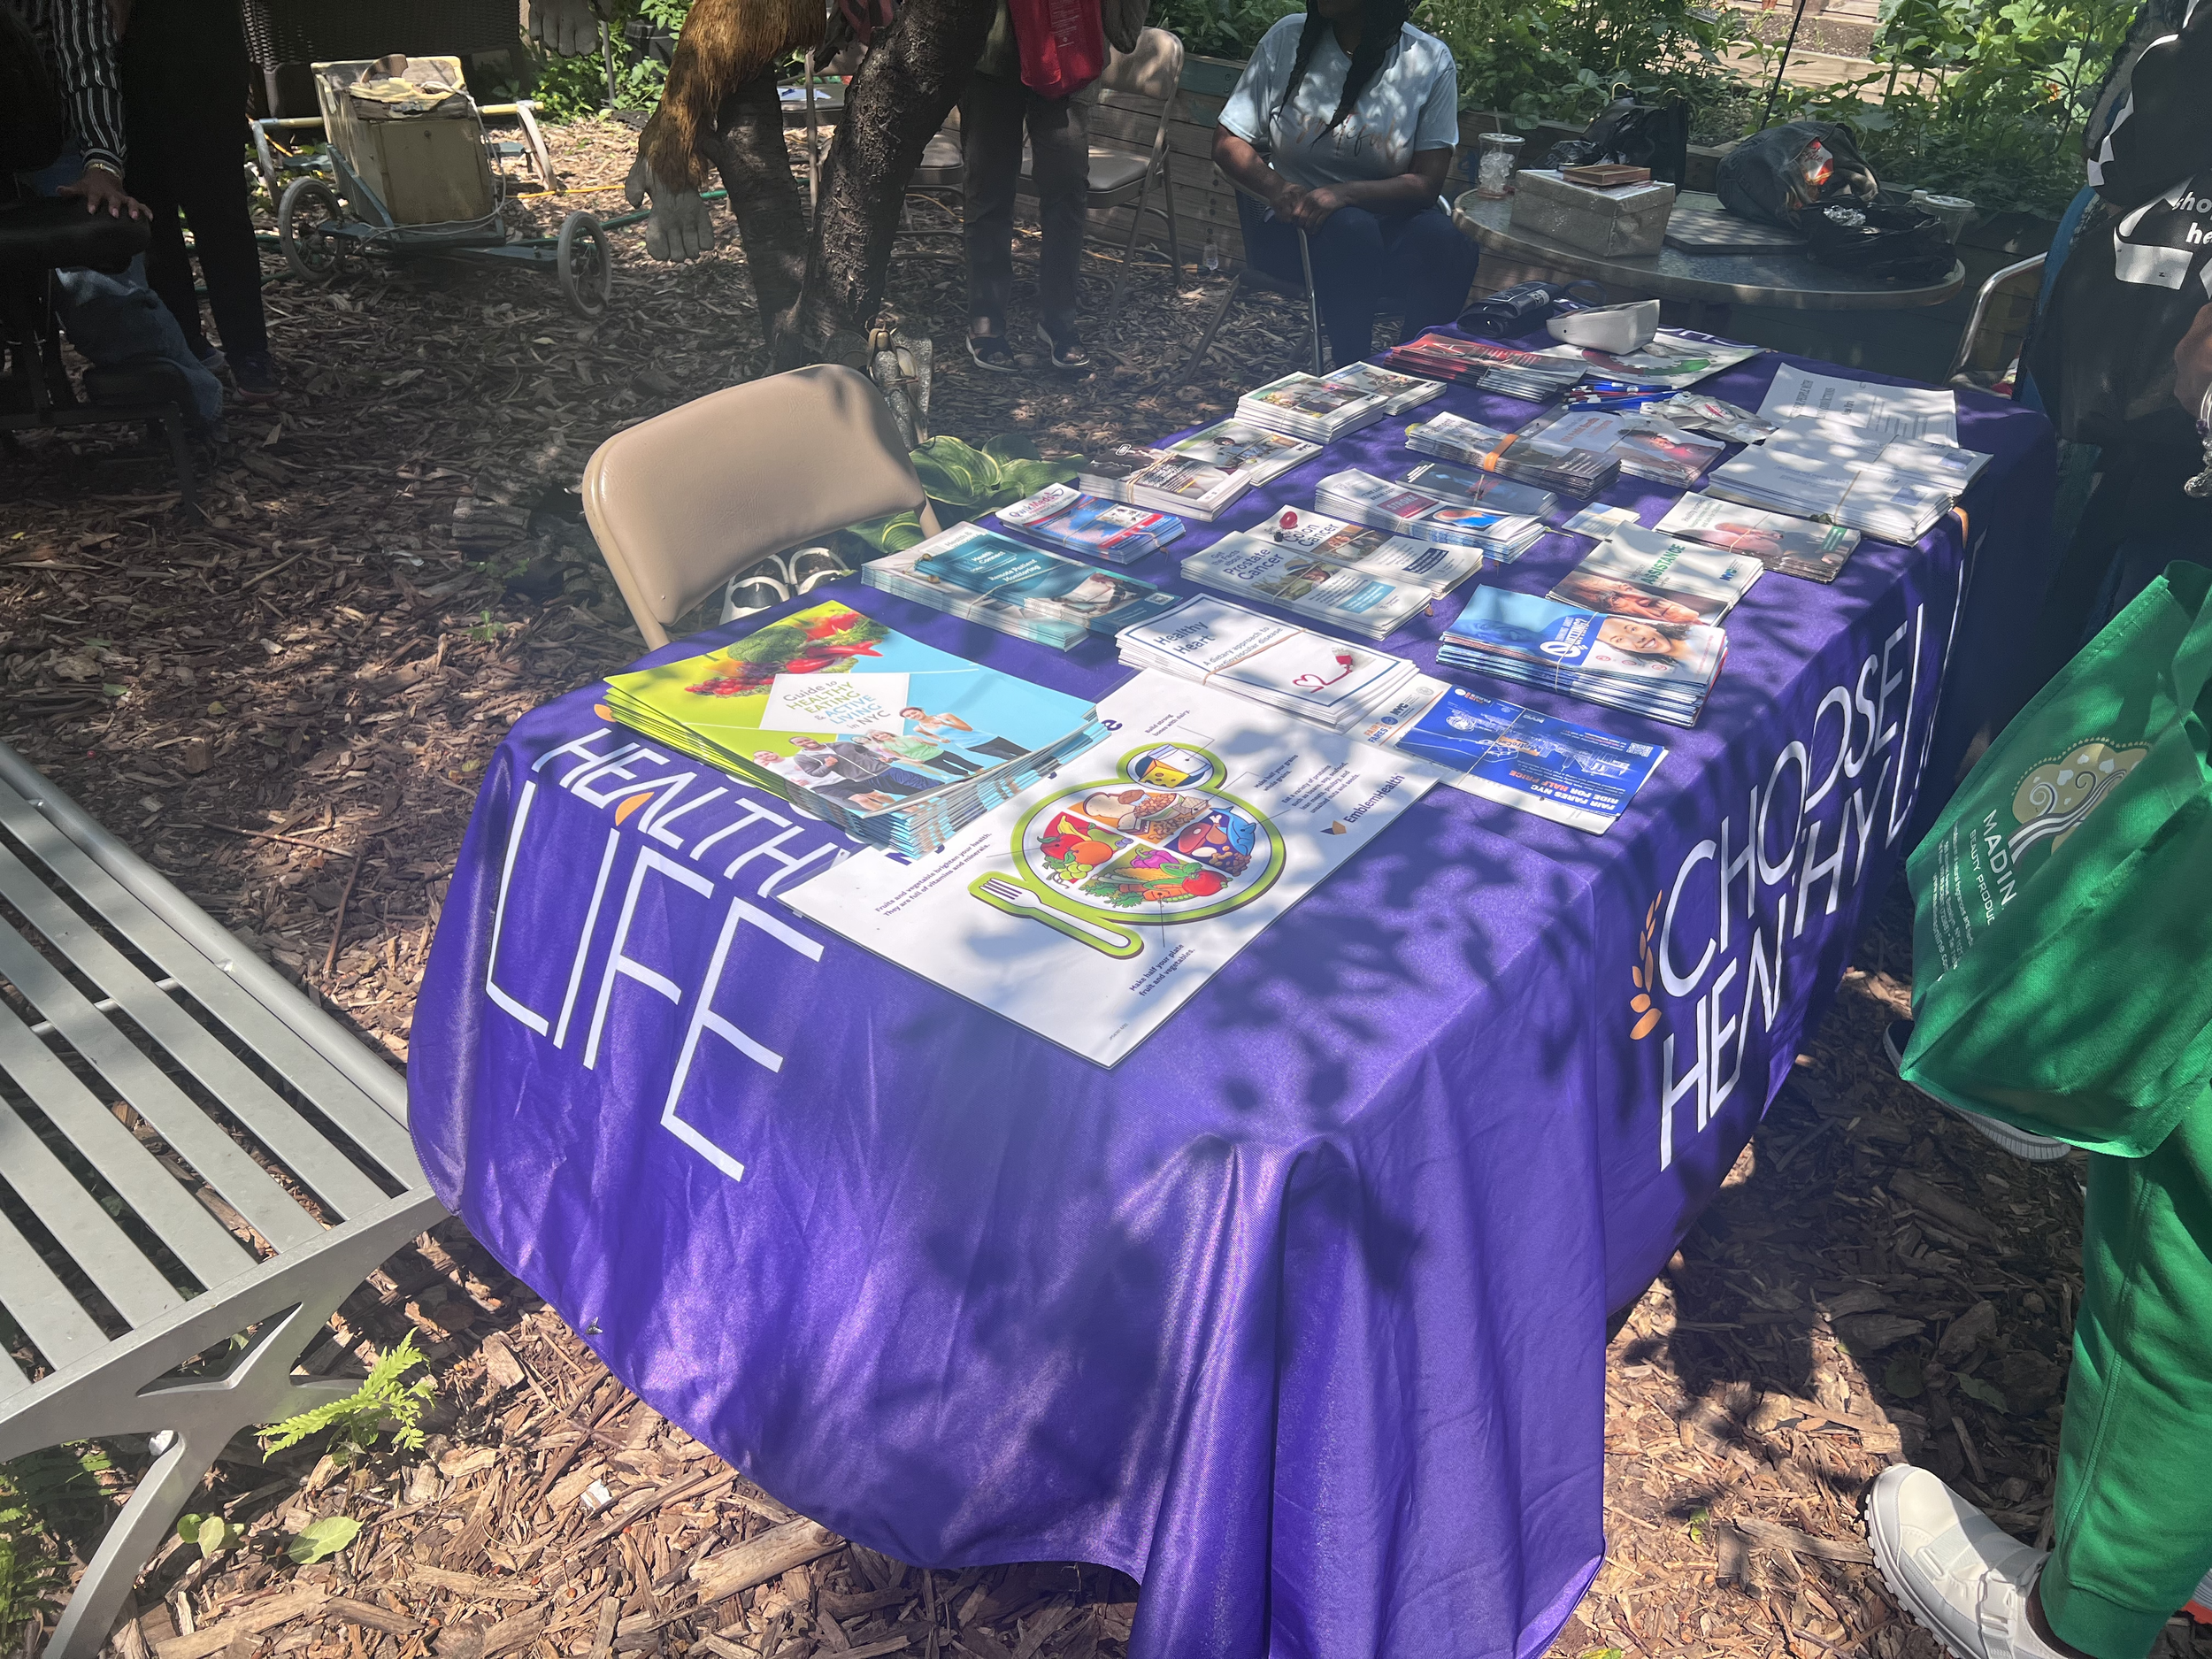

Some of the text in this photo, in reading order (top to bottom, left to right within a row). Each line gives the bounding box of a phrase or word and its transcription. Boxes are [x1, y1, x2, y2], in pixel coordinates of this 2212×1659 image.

[1386, 494, 1418, 511] STROKE
[1282, 524, 1320, 543] Colon
[1297, 523, 1340, 547] Cancer
[987, 566, 1015, 581] Remote
[1011, 558, 1038, 572] Patient
[1002, 565, 1041, 582] Monitoring
[1223, 548, 1271, 575] Prostate
[1224, 555, 1243, 567] about
[1237, 553, 1285, 580] Cancer
[1640, 543, 1686, 586] ASSISTANCE
[1153, 620, 1210, 646] Healthy
[1172, 634, 1217, 655] Heart
[1257, 627, 1284, 644] disease
[1209, 646, 1234, 663] dietary
[1232, 632, 1263, 652] approach
[783, 680, 838, 703] Guide to
[786, 681, 855, 710] HEALTHY
[804, 690, 861, 715] EATING
[826, 695, 877, 718] ACTIVE
[829, 703, 882, 725] LIVING
[847, 710, 891, 730] in NYC
[1367, 727, 1389, 744] FARES
[1284, 754, 1299, 767] grains
[1294, 781, 1311, 796] variety
[1312, 764, 1332, 781] proteins
[1325, 776, 1345, 793] poultry,
[1340, 770, 1351, 780] and
[1338, 783, 1348, 793] and
[1509, 770, 1619, 804] RIDE FOR HALF PRICE
[1342, 773, 1407, 823] EmblemHealth
[1530, 784, 1616, 810] FAIR FARES NYC
[1658, 620, 1909, 997] CHOOSE
[531, 727, 851, 898] HEALTH
[1970, 828, 1981, 872] BEAUTY
[1983, 809, 2017, 910] MADIN
[875, 833, 992, 912] Fruits and vegetable brighten your health.
[883, 904, 901, 917] They
[900, 897, 911, 907] are
[909, 890, 922, 900] full
[927, 870, 955, 888] vitamins
[952, 861, 965, 872] and
[964, 843, 991, 863] minerals.
[1129, 943, 1185, 992] Make half your plate
[1139, 949, 1196, 997] fruit and vegetables.
[486, 780, 825, 1182] LIFE
